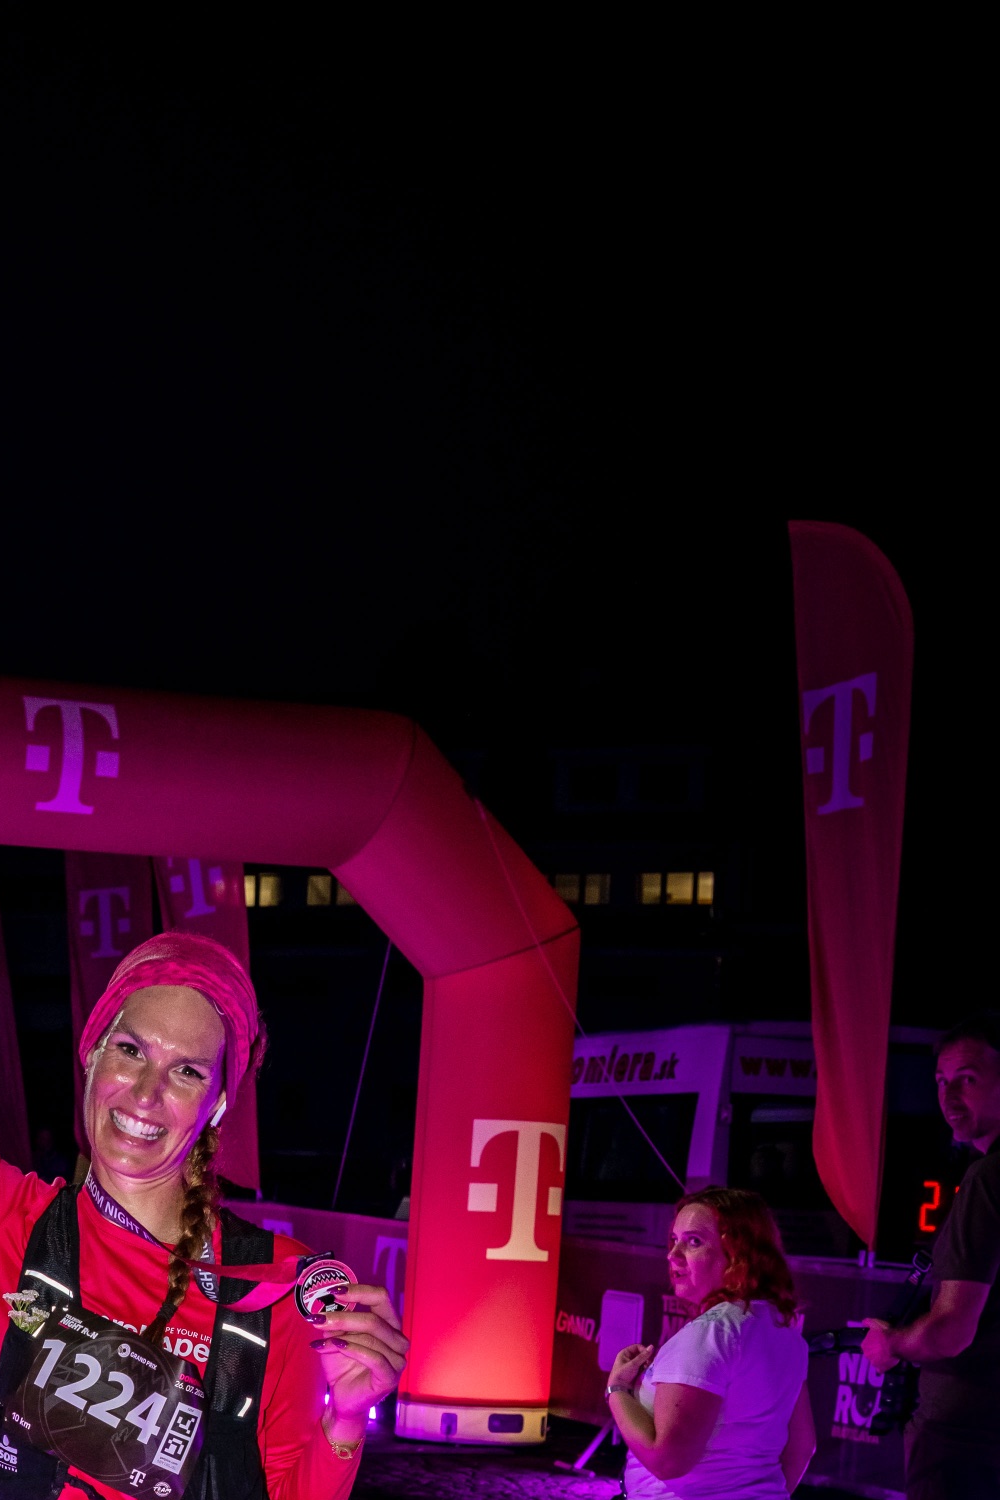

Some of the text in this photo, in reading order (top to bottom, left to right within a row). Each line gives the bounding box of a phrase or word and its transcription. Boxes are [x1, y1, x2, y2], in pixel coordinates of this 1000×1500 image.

[23, 695, 119, 815] T
[802, 671, 877, 815] T
[79, 886, 130, 958] T
[467, 1119, 566, 1262] T
[104, 1201, 140, 1234] NIGHT
[198, 1268, 220, 1303] NIGH
[60, 1317, 84, 1332] NIGHT
[176, 1327, 199, 1338] YOUR
[130, 1351, 158, 1371] GRAND PRIX
[33, 1339, 168, 1445] 1224
[11, 1411, 31, 1430] 10 km
[129, 1468, 147, 1487] T
